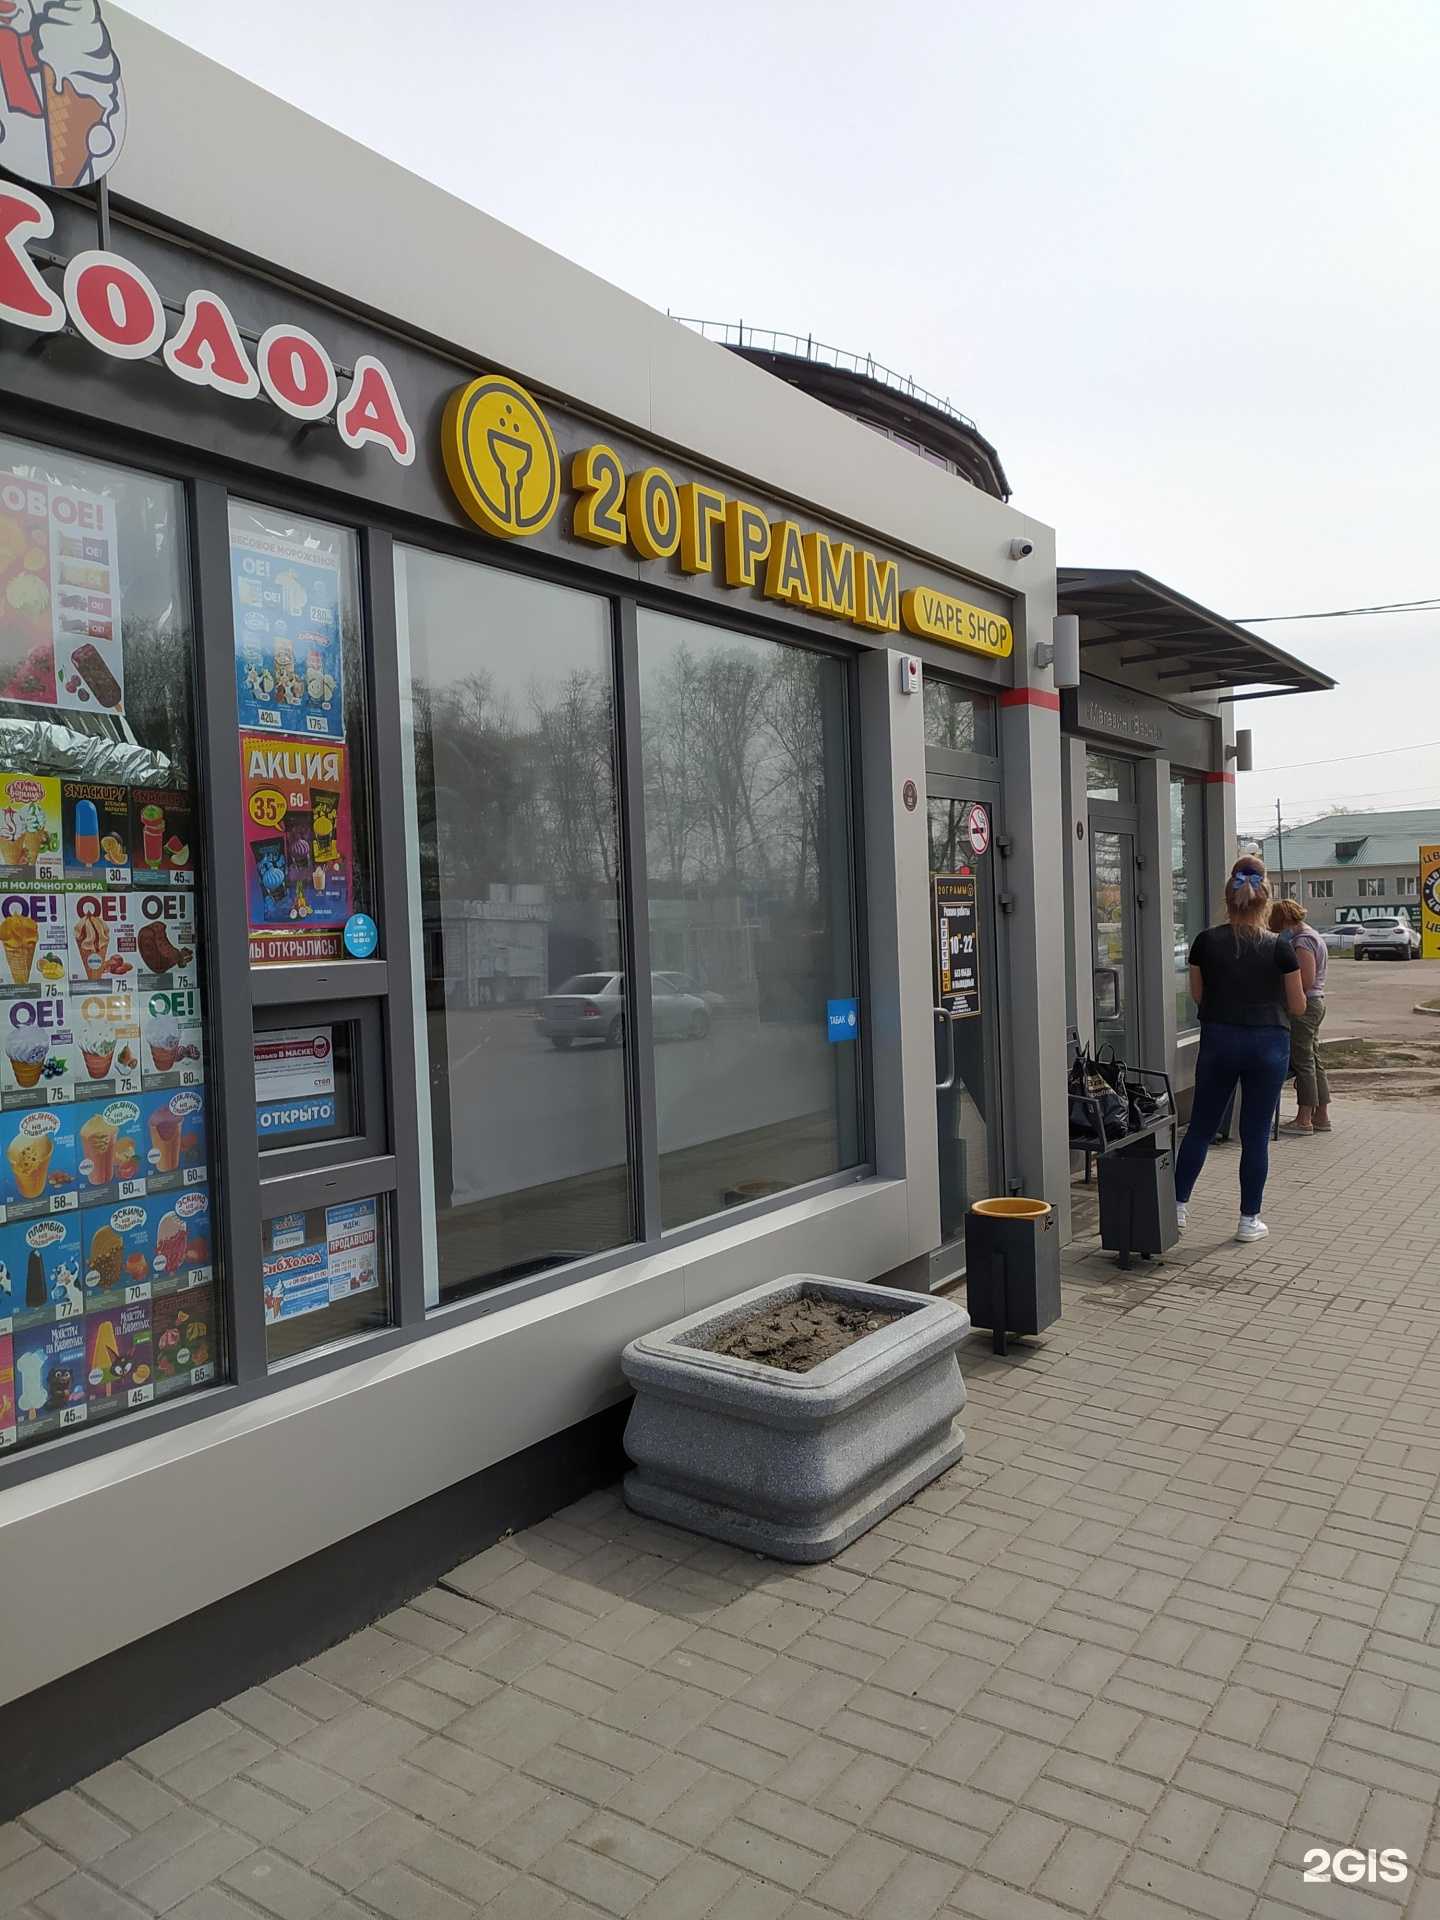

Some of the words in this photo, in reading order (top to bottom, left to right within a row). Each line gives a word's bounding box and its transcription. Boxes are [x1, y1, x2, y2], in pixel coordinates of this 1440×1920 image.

[922, 594, 963, 636] VAPE
[968, 611, 1007, 649] SHOP
[249, 750, 340, 784] АКЦИЯ
[254, 796, 277, 820] 35
[39, 866, 53, 880] 65
[109, 869, 121, 881] 30
[174, 871, 185, 884] 45
[10, 881, 74, 891] МОЛОЧНОГО
[75, 882, 104, 891] ЖИРА
[76, 895, 127, 921] ОЕ!
[141, 894, 186, 920] ОЕ!
[1335, 906, 1411, 923] ГАММА
[268, 939, 338, 958] ОТКРЫЛИСЬ!
[115, 980, 128, 992] 75
[178, 975, 189, 988] 75
[44, 984, 58, 997] 75
[148, 991, 194, 1018] ОЕ!
[9, 999, 64, 1028] ОЕ!
[829, 1015, 846, 1025] ТАБАК
[183, 1071, 194, 1084] 80
[120, 1078, 132, 1092] 75
[50, 1087, 63, 1101] 75
[260, 1104, 331, 1128] ОТКРЫТО
[186, 1169, 198, 1182] 60
[122, 1182, 134, 1195] 60
[53, 1195, 66, 1209] 58
[28, 1222, 65, 1239] ПЛОМБИР
[329, 1231, 374, 1252] ПРОДАВЦОВ
[192, 1270, 203, 1283] 70
[129, 1286, 141, 1300] 70
[60, 1302, 73, 1317] 77
[132, 1389, 143, 1403] 45
[63, 1409, 76, 1423] 45
